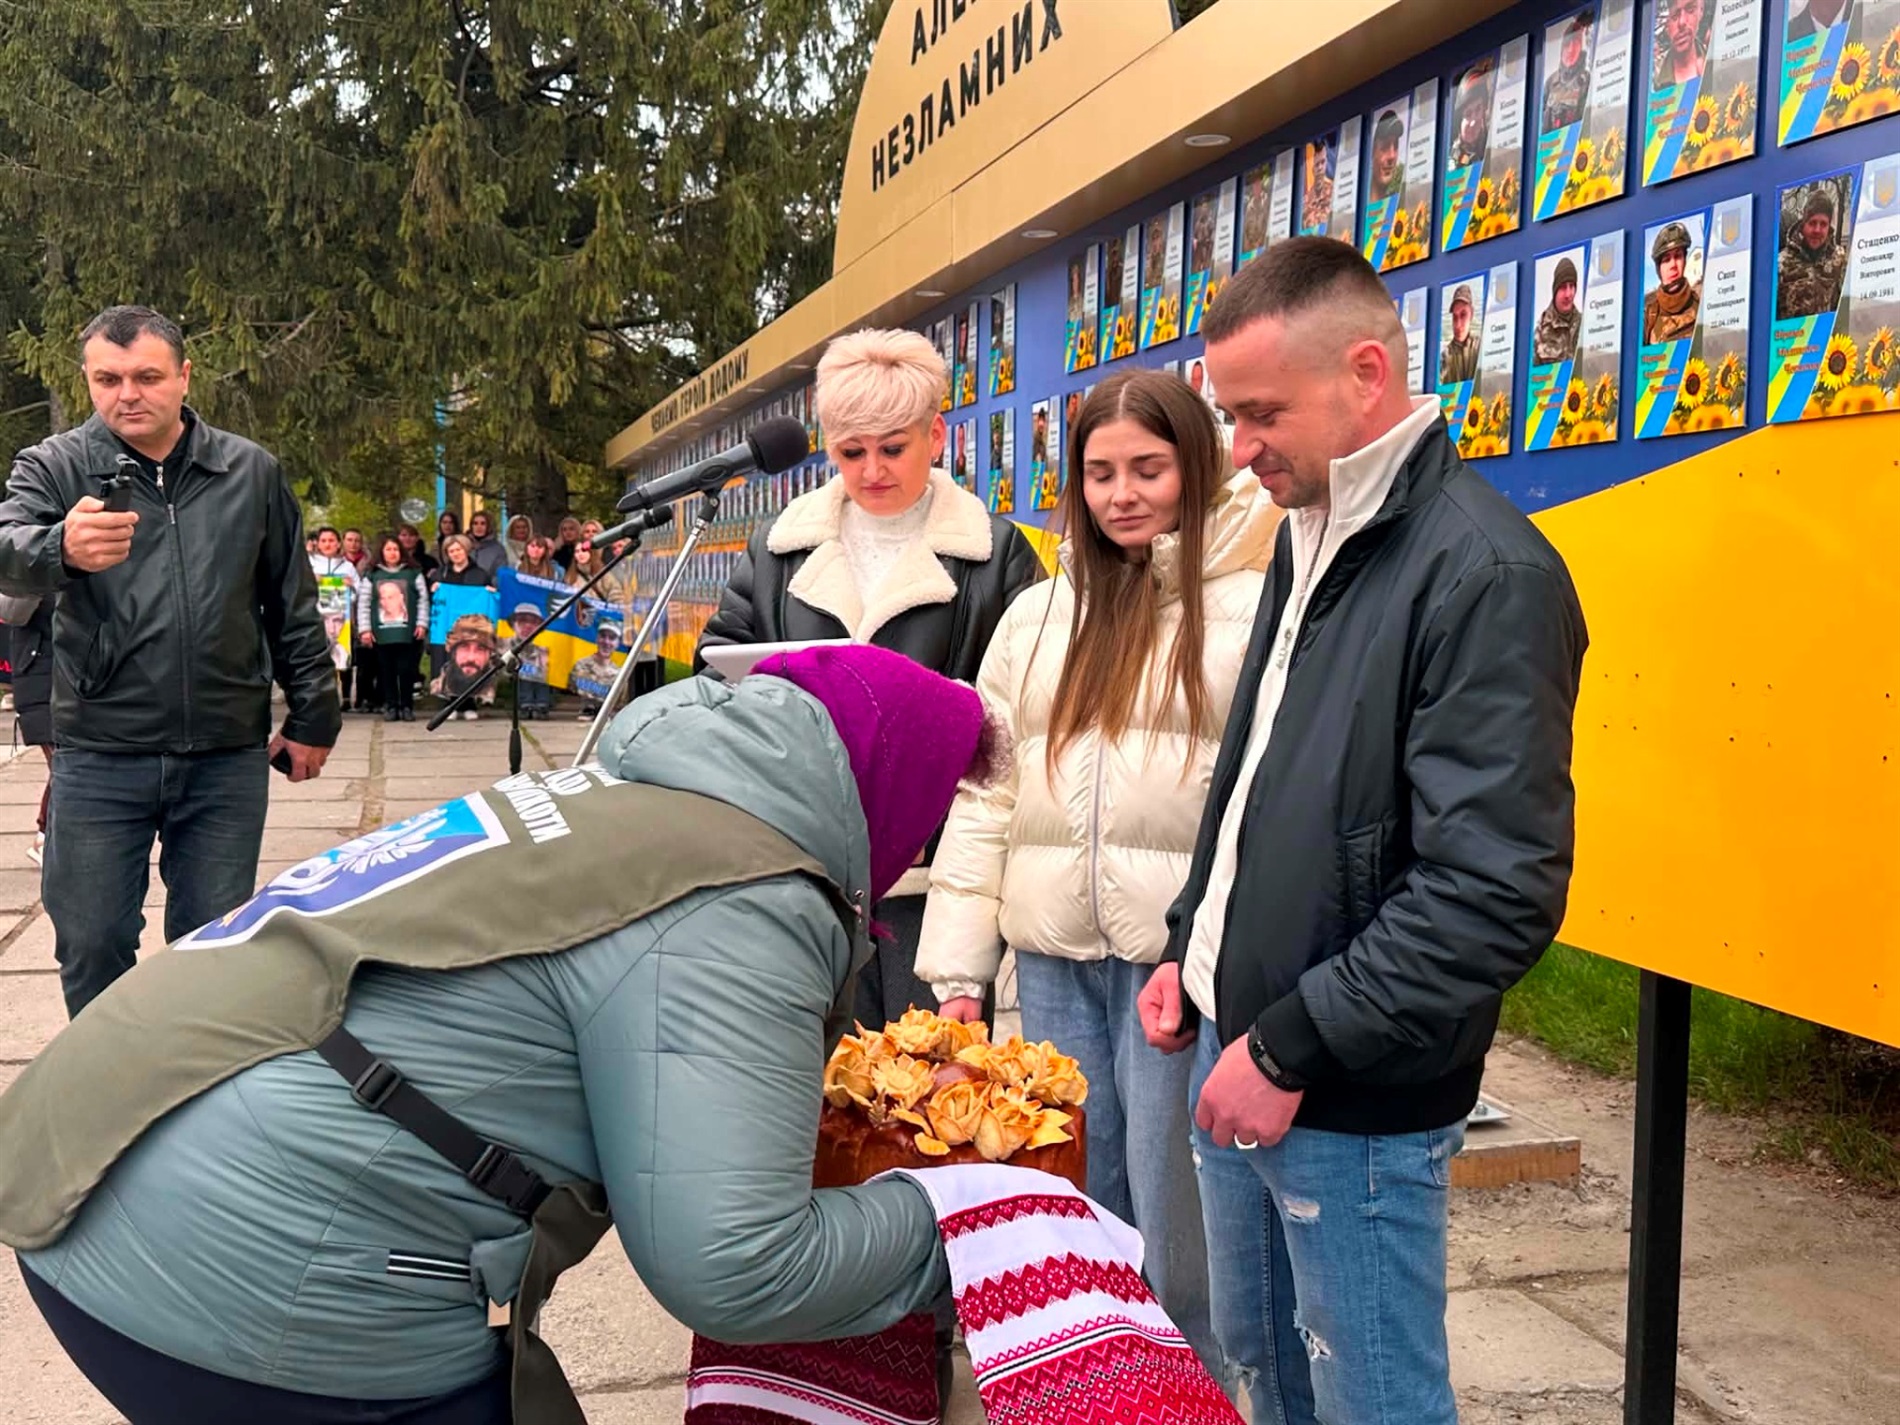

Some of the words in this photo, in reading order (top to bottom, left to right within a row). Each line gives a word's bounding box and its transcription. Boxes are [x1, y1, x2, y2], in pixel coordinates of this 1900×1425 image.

[911, 0, 976, 66] АЛ
[872, 0, 1063, 193] НЕЗЛАМНИХ
[1857, 233, 1900, 250] Стаценко
[710, 348, 749, 404] ДОДОМУ
